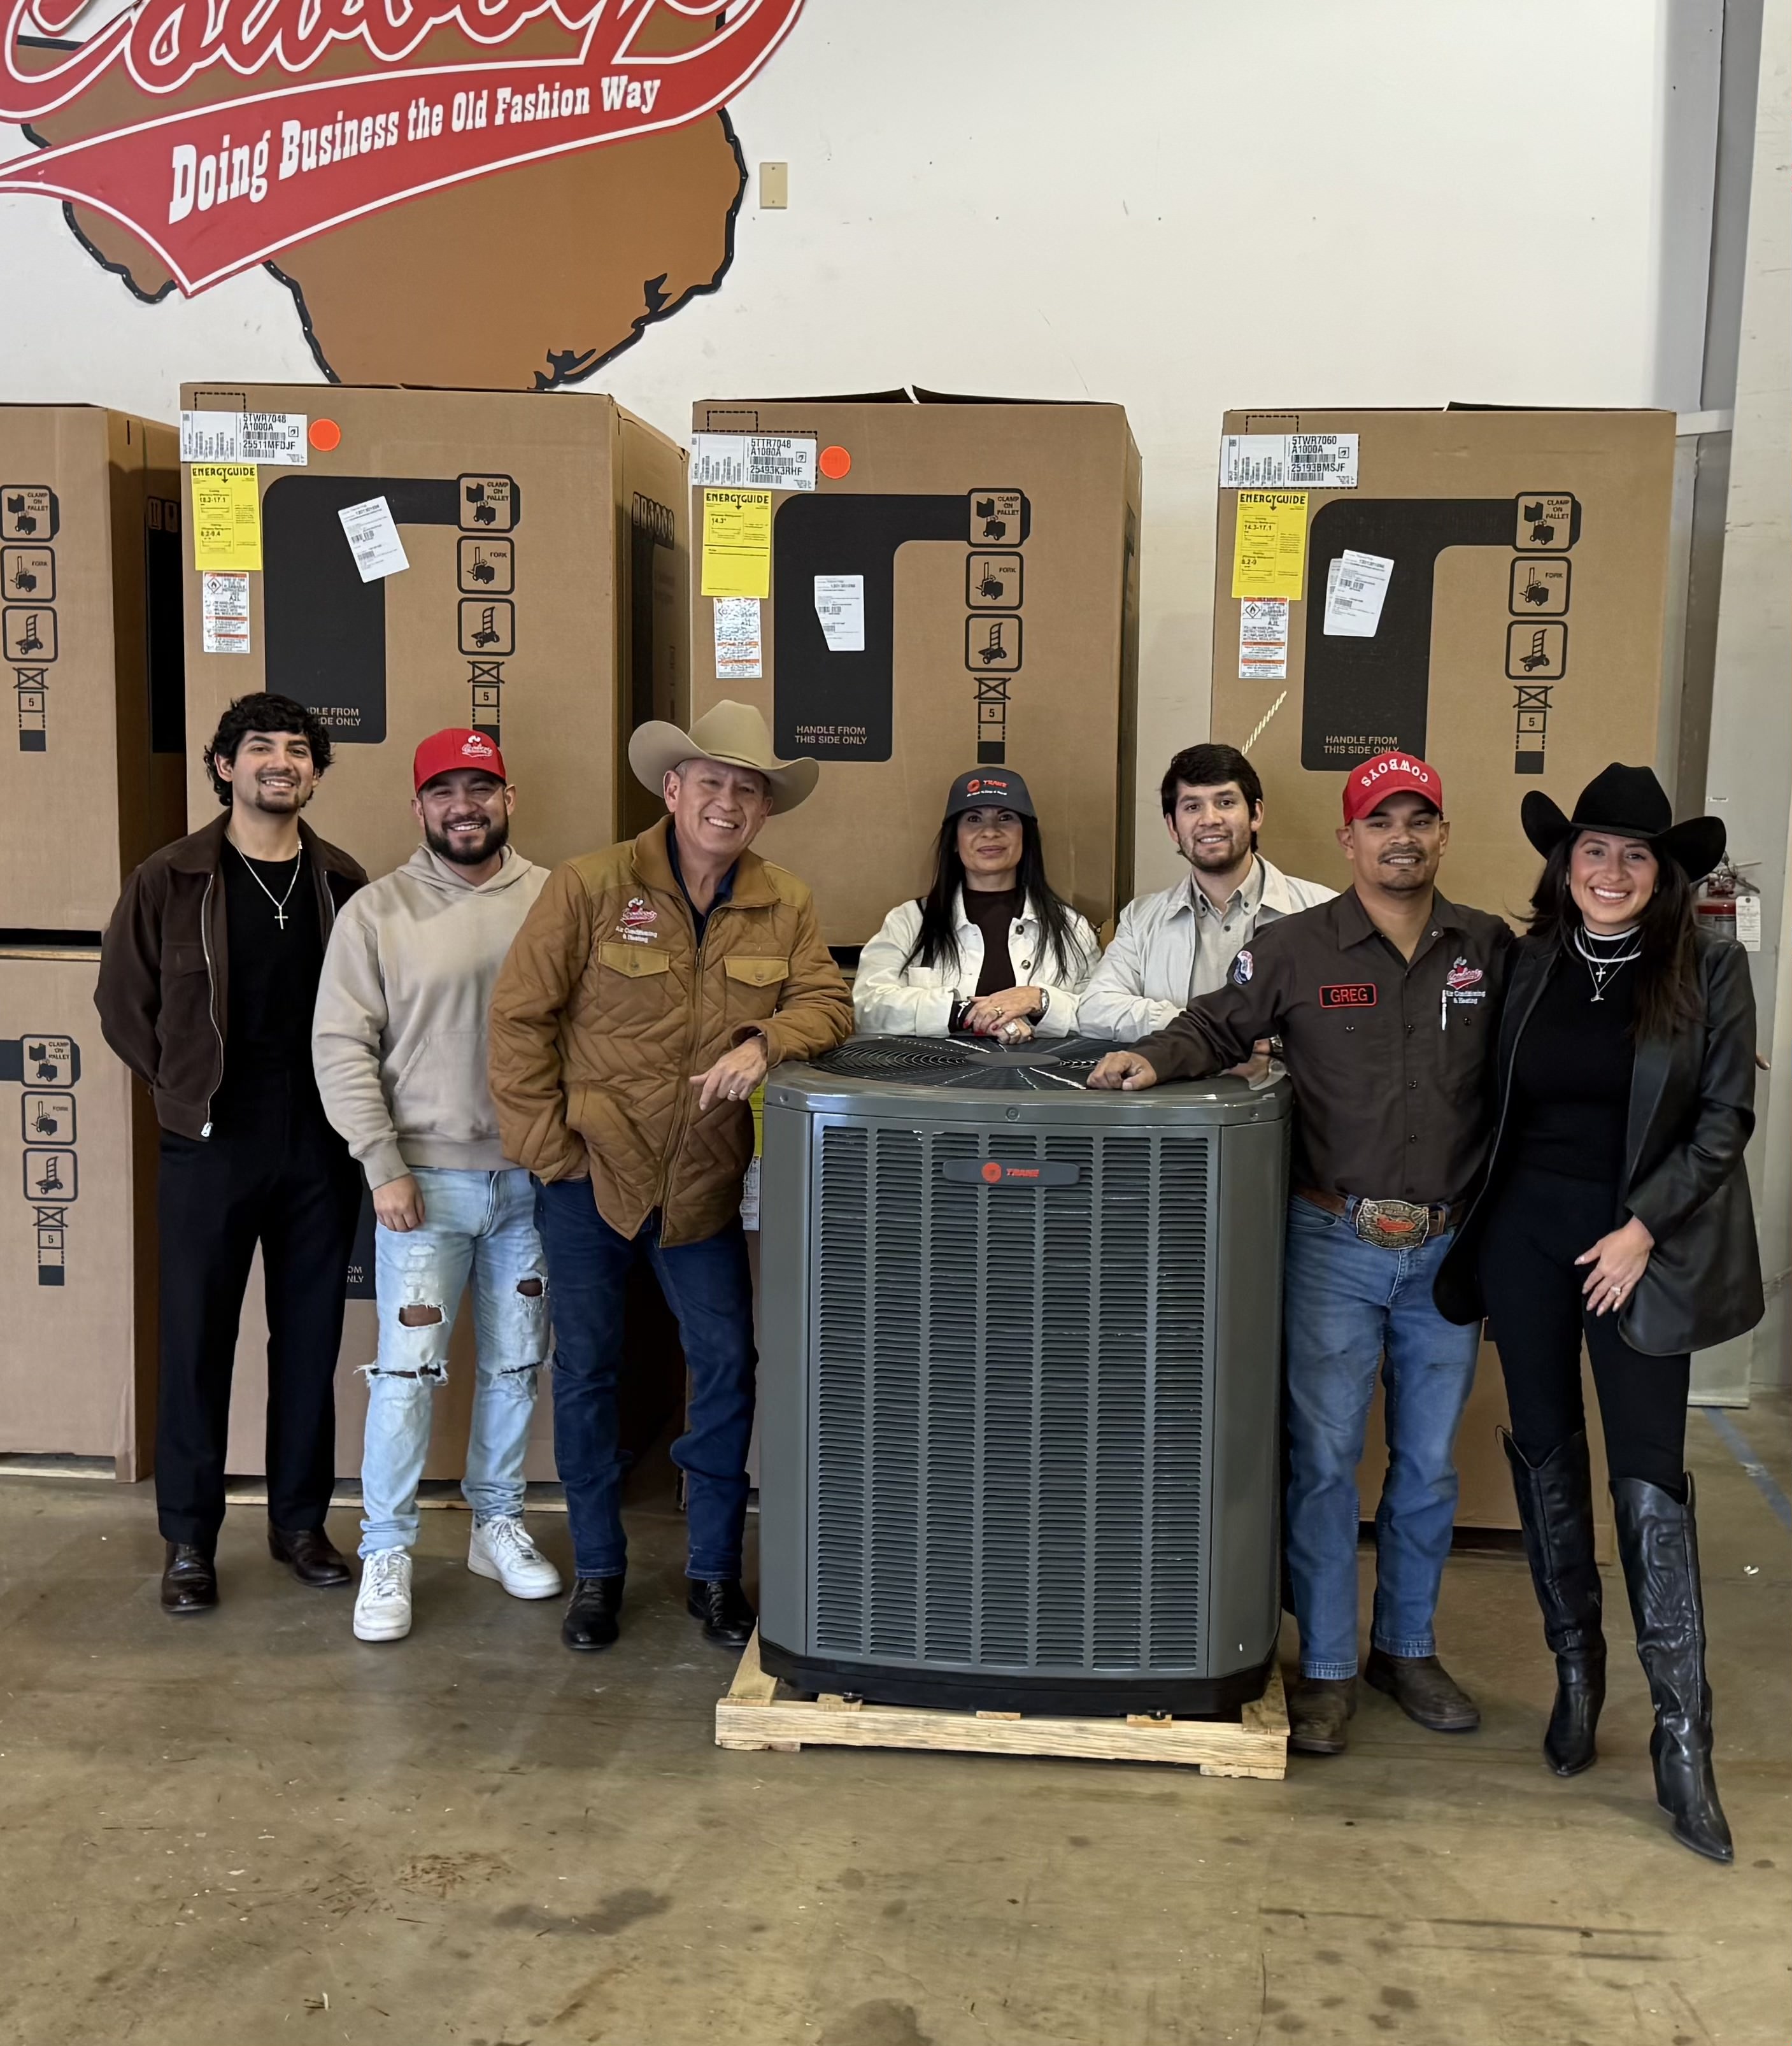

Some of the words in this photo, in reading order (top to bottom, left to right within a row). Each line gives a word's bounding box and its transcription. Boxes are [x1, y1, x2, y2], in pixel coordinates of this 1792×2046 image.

[169, 130, 271, 224] Doing
[278, 110, 399, 180] Business
[407, 97, 443, 141] the
[451, 89, 488, 132] Old
[494, 82, 589, 125] Fashion
[601, 75, 660, 114] Way
[1292, 436, 1337, 444] 5TWR7060
[484, 692, 490, 700] 5
[28, 698, 34, 707] 5
[331, 707, 359, 716] FROM
[989, 709, 995, 718] 5
[336, 718, 361, 726] ONLY
[1529, 718, 1535, 727] 5
[795, 735, 815, 744] THIS
[818, 735, 840, 744] SIDE
[843, 736, 867, 744] ONLY
[1326, 735, 1365, 744] HANDLE
[1369, 736, 1397, 744] FROM
[1324, 746, 1345, 754] THIS
[1361, 758, 1428, 787] COWBOYS
[1330, 988, 1367, 1002] GREG
[48, 1235, 53, 1244] 5
